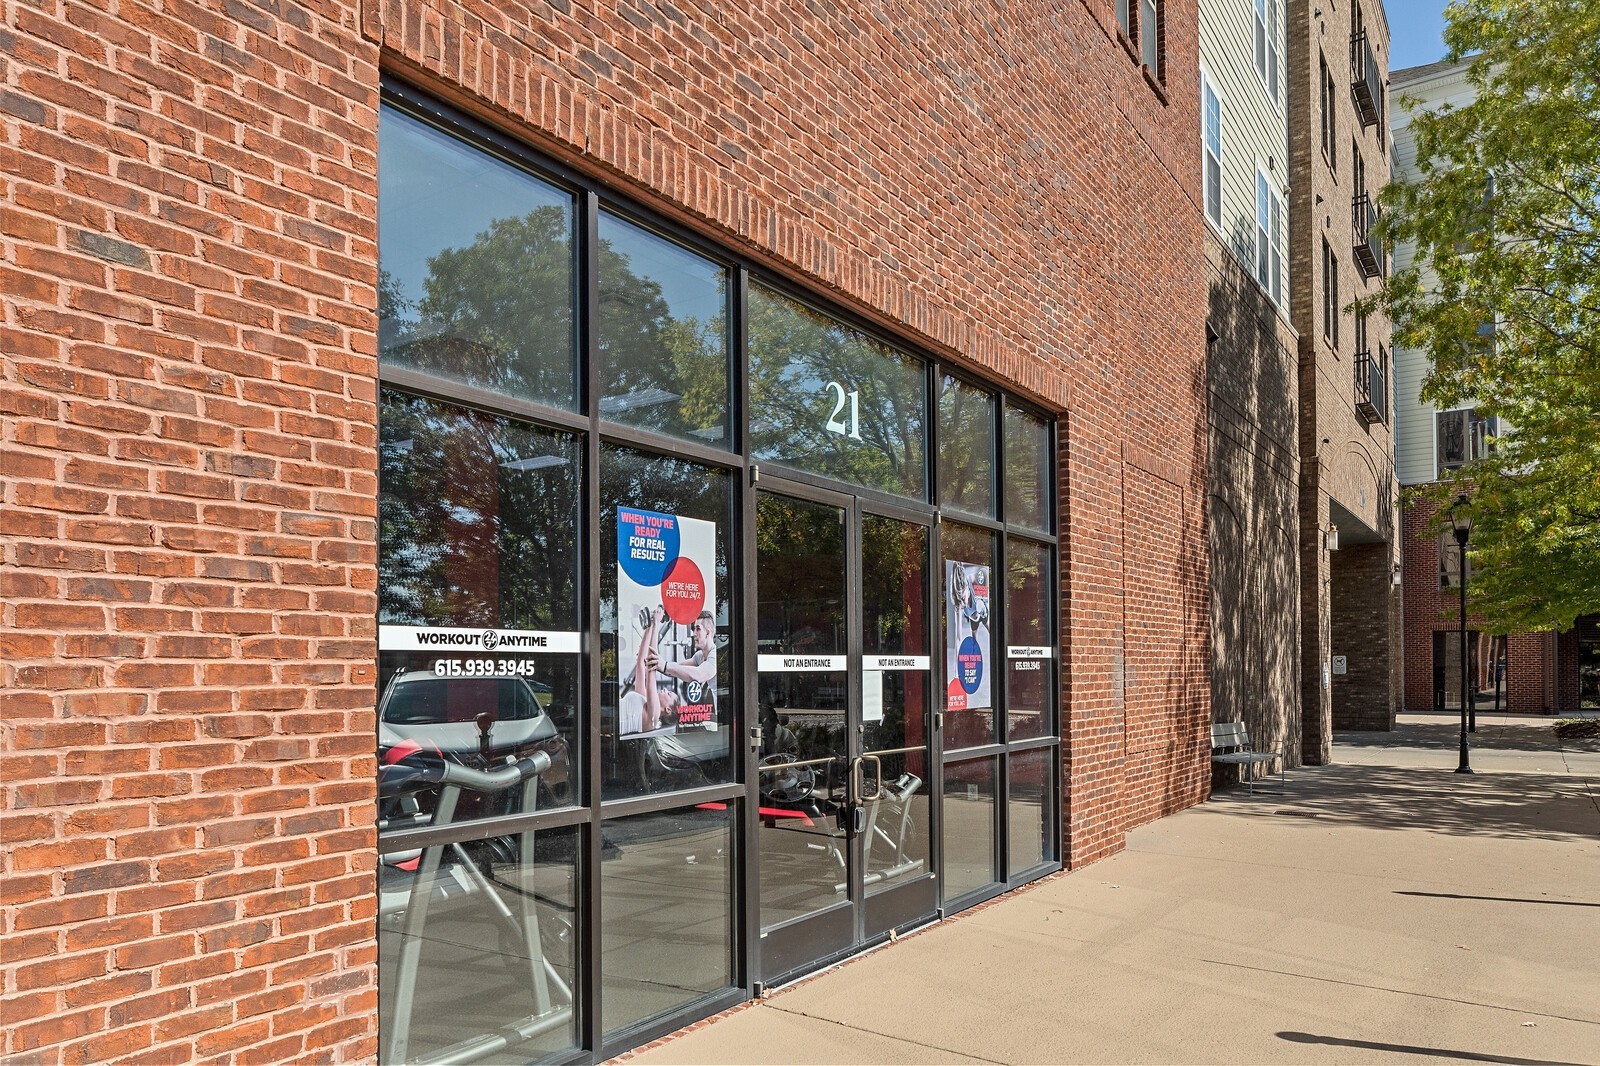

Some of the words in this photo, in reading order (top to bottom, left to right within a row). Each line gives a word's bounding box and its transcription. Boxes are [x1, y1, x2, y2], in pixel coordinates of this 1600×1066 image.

[825, 381, 863, 441] 21
[621, 512, 645, 524] WHEN
[647, 516, 674, 529] YOU'RE
[634, 526, 661, 538] READY
[629, 536, 645, 548] FOR
[646, 539, 666, 550] REAL
[631, 548, 665, 561] RESULTS
[668, 581, 685, 590] WE'RE
[685, 583, 699, 592] HERE
[665, 589, 677, 598] FOR
[416, 632, 481, 645] WORKOUT
[498, 635, 548, 647] ANYTIME
[434, 659, 535, 677] 615.939.3945
[783, 658, 796, 668] NOT
[796, 658, 804, 668] AN
[804, 658, 832, 668] ENTRANCE
[878, 658, 888, 667] NOT
[888, 658, 895, 667] AN
[894, 658, 916, 667] ENTRANCE
[676, 704, 713, 714] WORKOUT
[679, 713, 711, 723] ANYTIME
